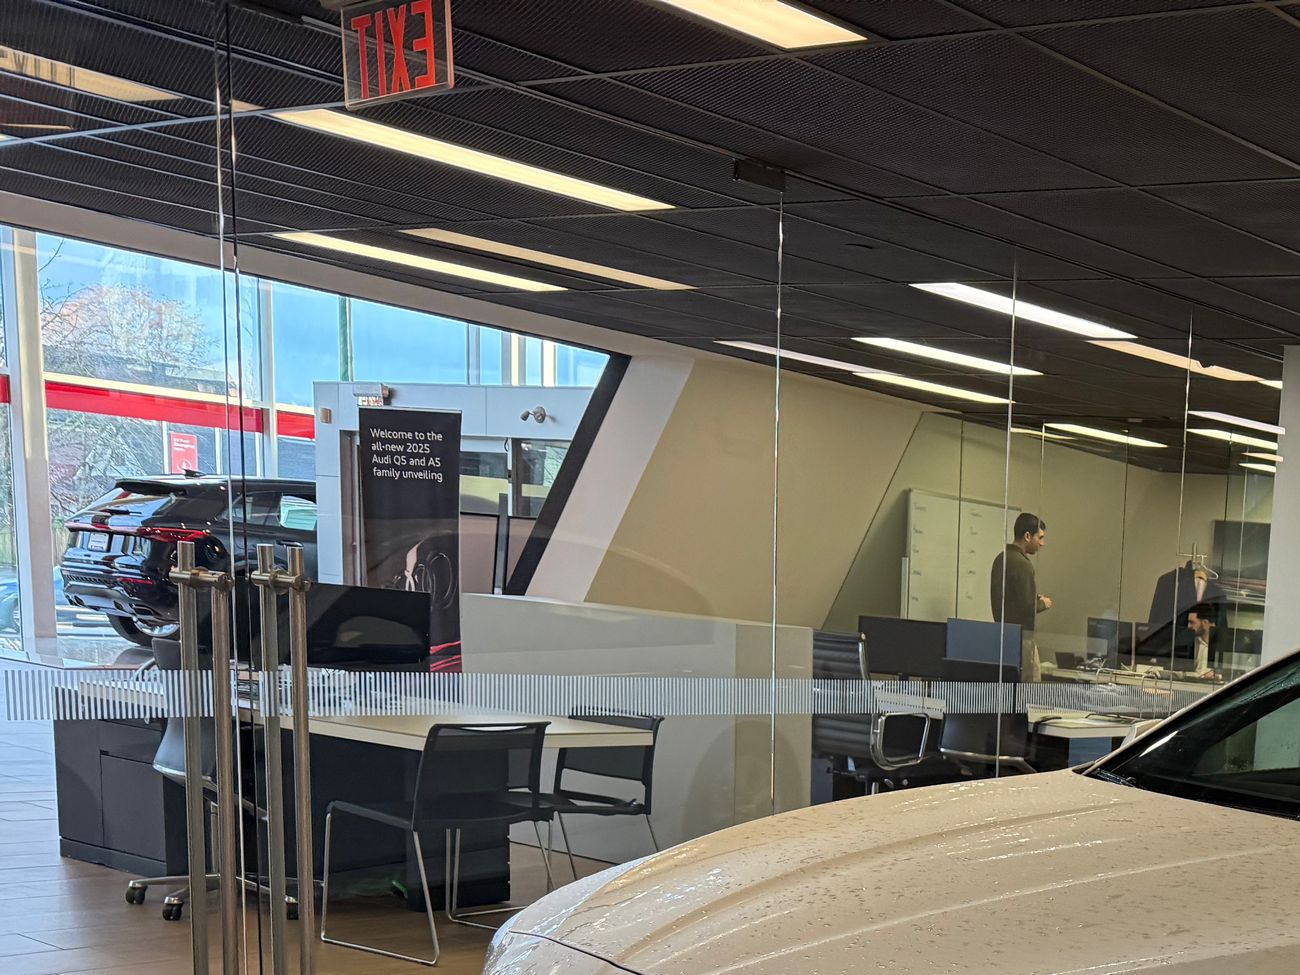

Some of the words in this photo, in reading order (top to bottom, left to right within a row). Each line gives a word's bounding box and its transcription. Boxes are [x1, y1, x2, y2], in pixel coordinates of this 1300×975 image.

[370, 428, 413, 439] Welcome
[415, 431, 425, 440] to
[427, 432, 443, 441] the
[371, 441, 404, 452] all-new
[406, 443, 430, 454] 2025
[372, 454, 392, 464] Audi
[393, 455, 407, 465] Q5
[409, 457, 426, 467] and
[428, 457, 441, 467] A5
[373, 467, 400, 479] family
[402, 469, 443, 482] unveiling
